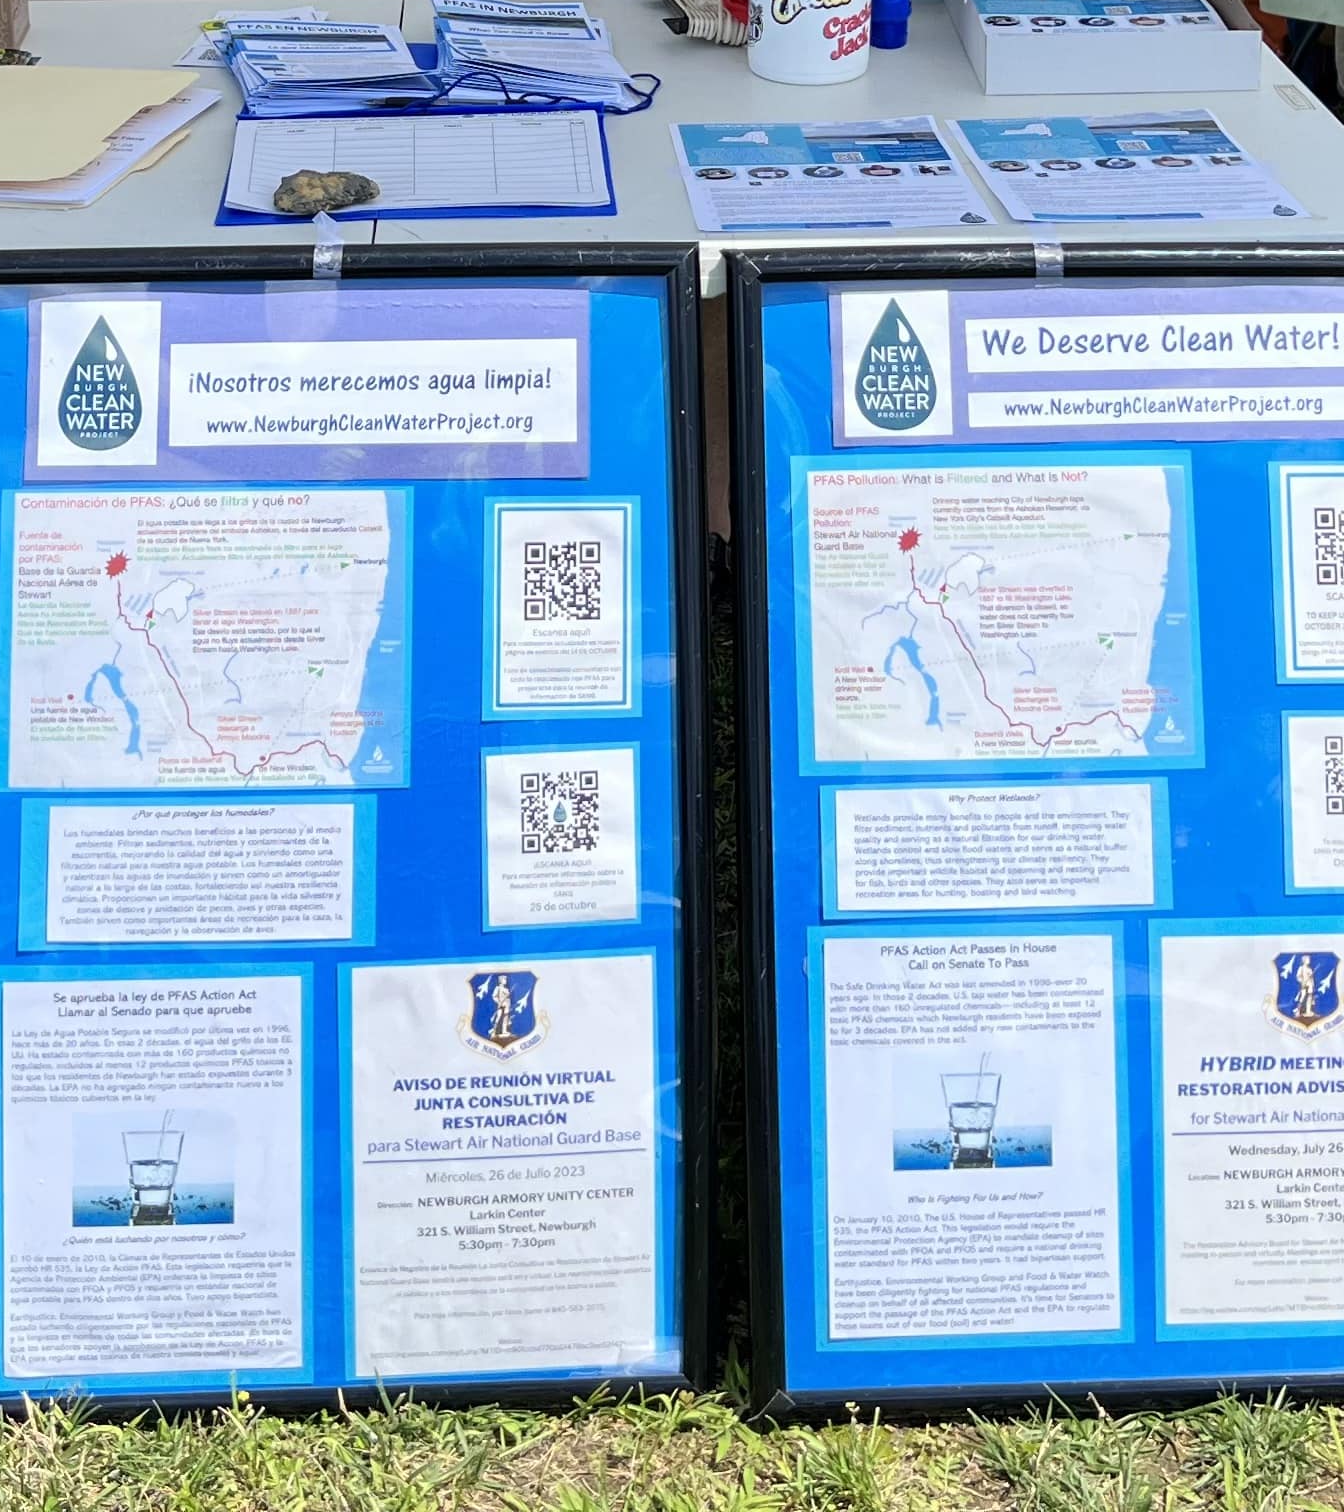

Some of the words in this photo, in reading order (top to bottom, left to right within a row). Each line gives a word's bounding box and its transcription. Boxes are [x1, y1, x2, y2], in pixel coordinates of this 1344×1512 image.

[443, 0, 476, 9] PFAS
[479, 4, 495, 12] IN
[498, 7, 577, 17] NEWBURGH
[982, 329, 1026, 356] We
[1038, 325, 1149, 354] Deserve
[1161, 324, 1232, 352] Clean
[1245, 322, 1338, 350] Water!
[871, 346, 917, 362] NEW
[76, 364, 124, 381] NEW
[189, 371, 290, 392] ¡Nosotros
[300, 375, 419, 391] merecemos
[428, 374, 474, 394] agua
[485, 367, 550, 395] limpia!
[863, 375, 929, 392] CLEAN
[66, 394, 134, 411] CLEAN
[864, 394, 929, 410] WATER
[1004, 394, 1322, 417] www.NewburghCleanWaterProject.org
[66, 413, 134, 430] WATER
[207, 412, 532, 436] www.NewburghCleanWaterProject.org
[813, 472, 844, 486] PFAS
[847, 474, 897, 485] Pollution:
[902, 473, 931, 487] What
[947, 472, 987, 483] Filtered
[991, 472, 1012, 483] and
[1015, 472, 1045, 482] What
[1061, 470, 1088, 481] Not?
[20, 496, 108, 508] Contaminación
[111, 497, 126, 508] de
[130, 496, 164, 507] PFAS:
[167, 496, 200, 510] ¿Qué
[203, 498, 217, 507] se
[252, 498, 258, 509] y
[262, 494, 284, 509] qué
[287, 494, 310, 505] no?
[813, 507, 843, 516] Source
[845, 507, 854, 515] of
[856, 506, 878, 514] PFAS
[814, 530, 845, 539] Stewart
[848, 530, 859, 538] Air
[862, 530, 898, 539] National
[814, 542, 840, 550] Guard
[842, 541, 864, 550] Base
[880, 945, 909, 956] PFAS
[912, 944, 946, 955] Action
[949, 944, 967, 954] Act
[970, 943, 1006, 954] Passes
[1023, 942, 1056, 952] House
[908, 959, 928, 970] Call
[932, 961, 945, 969] on
[948, 958, 984, 969] Senate
[987, 957, 1001, 968] To
[1005, 957, 1029, 967] Pass
[53, 992, 66, 1002] Se
[70, 992, 114, 1005] aprueba
[118, 992, 128, 1001] la
[132, 992, 146, 1004] ley
[150, 991, 164, 1001] de
[168, 990, 197, 1000] PFAS
[200, 989, 234, 1000] Action
[238, 989, 256, 1000] Act
[58, 1007, 94, 1017] Llamar
[98, 1006, 107, 1016] al
[111, 1006, 151, 1016] Senado
[155, 1007, 179, 1017] para
[182, 1007, 203, 1016] que
[207, 1004, 251, 1016] apruebe
[1200, 1055, 1276, 1072] HYBRID
[393, 1078, 441, 1091] AVISO
[445, 1077, 466, 1089] DE
[470, 1072, 541, 1088] REUNIÓN
[546, 1070, 614, 1085] VIRTUAL
[1178, 1081, 1292, 1096] RESTORATION
[414, 1097, 464, 1110] JUNTA
[468, 1092, 569, 1108] CONSULTIVA
[573, 1090, 594, 1103] DE
[442, 1109, 566, 1129] RESTAURACIÓN
[1190, 1111, 1210, 1125] for
[1213, 1111, 1266, 1124] Stewart
[1270, 1110, 1289, 1123] Air
[368, 1141, 400, 1154] para
[404, 1136, 462, 1152] Stewart
[466, 1135, 488, 1149] Air
[492, 1132, 552, 1148] National
[556, 1129, 601, 1144] Guard
[605, 1128, 640, 1142] Base
[1228, 1143, 1299, 1157] Wednesday,
[1302, 1143, 1324, 1155] July
[488, 1169, 504, 1181] 26
[506, 1168, 521, 1180] de
[524, 1167, 550, 1179] Julio
[553, 1165, 585, 1178] 2023
[1223, 1168, 1292, 1180] NEWBURGH
[1276, 1183, 1310, 1193] Larkin
[418, 1194, 488, 1207] NEWBURGH
[491, 1192, 544, 1204] ARMORY
[547, 1190, 583, 1201] UNITY
[586, 1187, 633, 1199] CENTER
[1224, 1199, 1245, 1210] 321
[1260, 1198, 1301, 1208] William
[1304, 1197, 1340, 1208] Street,
[469, 1209, 505, 1220] Larkin
[507, 1207, 545, 1218] Center
[1265, 1213, 1308, 1224] 5:30pm
[417, 1226, 437, 1237] 321
[453, 1224, 495, 1235] William
[497, 1222, 536, 1234] Street,
[538, 1219, 596, 1233] Newburgh
[458, 1239, 502, 1251] 5:30pm
[512, 1236, 555, 1248] 7:30pm
